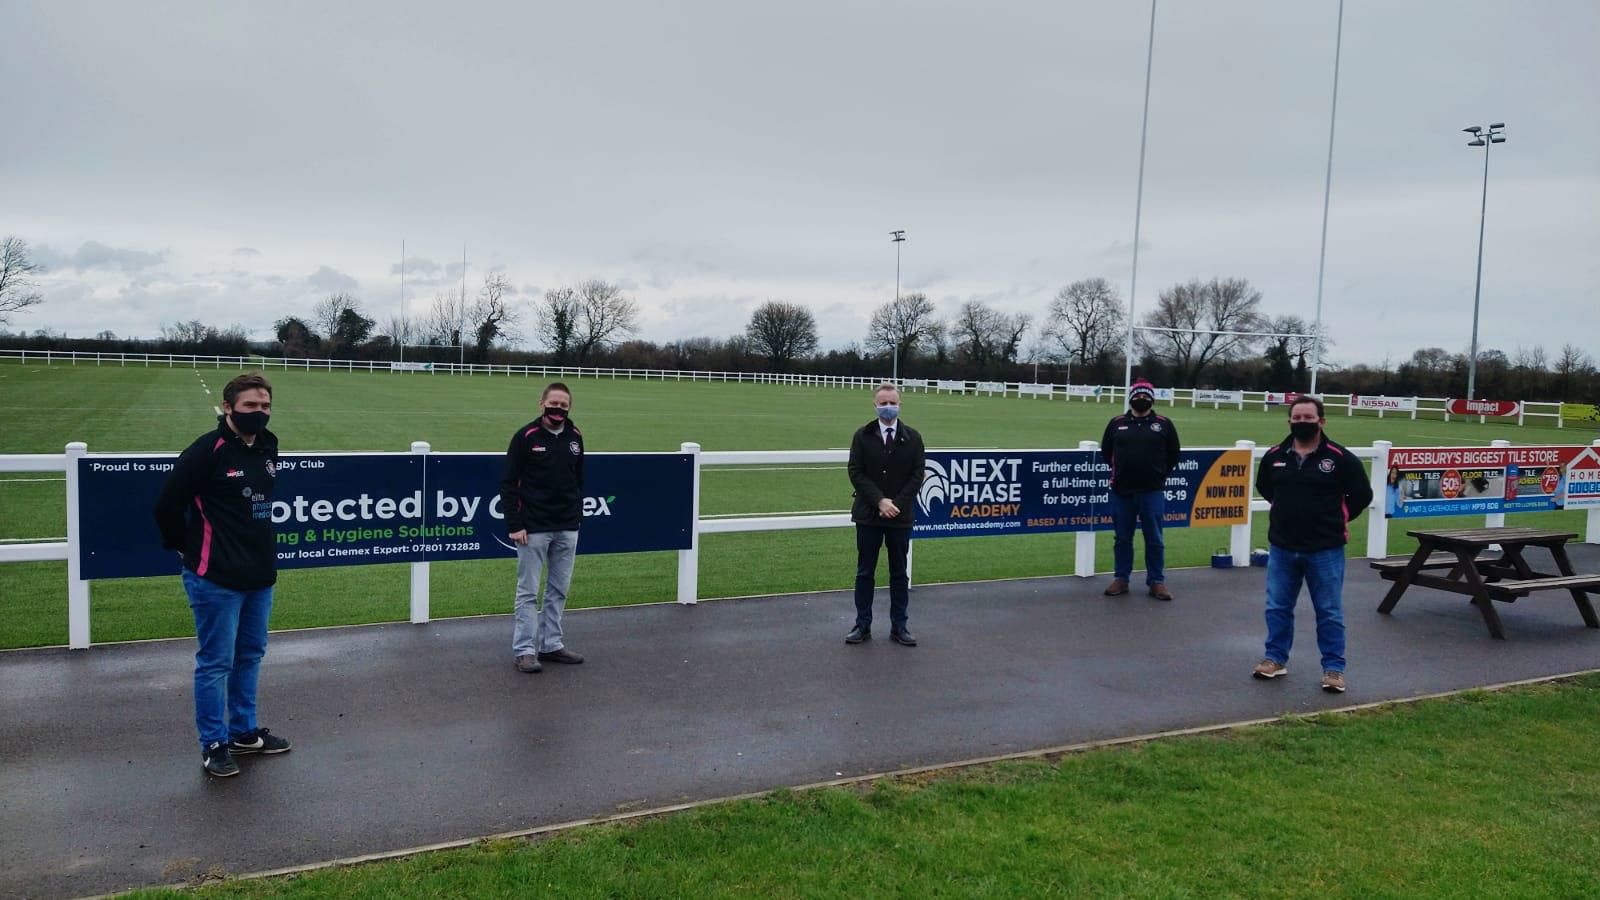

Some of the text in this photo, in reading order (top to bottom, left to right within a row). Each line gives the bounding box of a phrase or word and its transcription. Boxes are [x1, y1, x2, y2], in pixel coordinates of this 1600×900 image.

[1392, 450, 1559, 465] AYLESBURY'S BIGGEST TILE STORE
[93, 462, 130, 472] Proud
[133, 462, 146, 471] to
[276, 460, 296, 470] gby
[299, 459, 325, 469] Club
[950, 458, 1022, 482] NEXT
[1032, 461, 1072, 473] Further
[1178, 460, 1198, 470] with
[1220, 465, 1247, 477] APPLY
[1404, 472, 1422, 480] WALL
[1424, 472, 1440, 480] TILES
[1462, 471, 1482, 479] FLOOR
[1484, 470, 1498, 478] TILES
[1524, 469, 1536, 477] TILE
[1042, 480, 1049, 489] a
[1052, 477, 1096, 488] full-time
[950, 483, 1021, 503] PHASE
[1206, 485, 1245, 498] NOW FOR
[1043, 493, 1059, 504] for
[1061, 493, 1086, 507] boys
[1089, 492, 1109, 503] and
[271, 490, 422, 523] otected
[437, 490, 481, 522] by
[950, 504, 1020, 518] ACADEMY
[1195, 506, 1244, 519] SEPTEMBER
[913, 521, 1021, 531] www.nextphaseacademy.com
[1027, 518, 1056, 527] BASED
[1057, 517, 1068, 525] AT
[1070, 516, 1099, 525] STOKE
[276, 524, 474, 545] ng & Hygiene Solutions
[299, 548, 324, 558] local
[328, 548, 370, 557] Chemex
[373, 545, 410, 556] Expert:
[412, 544, 442, 552] 07801
[445, 542, 480, 551] 732828
